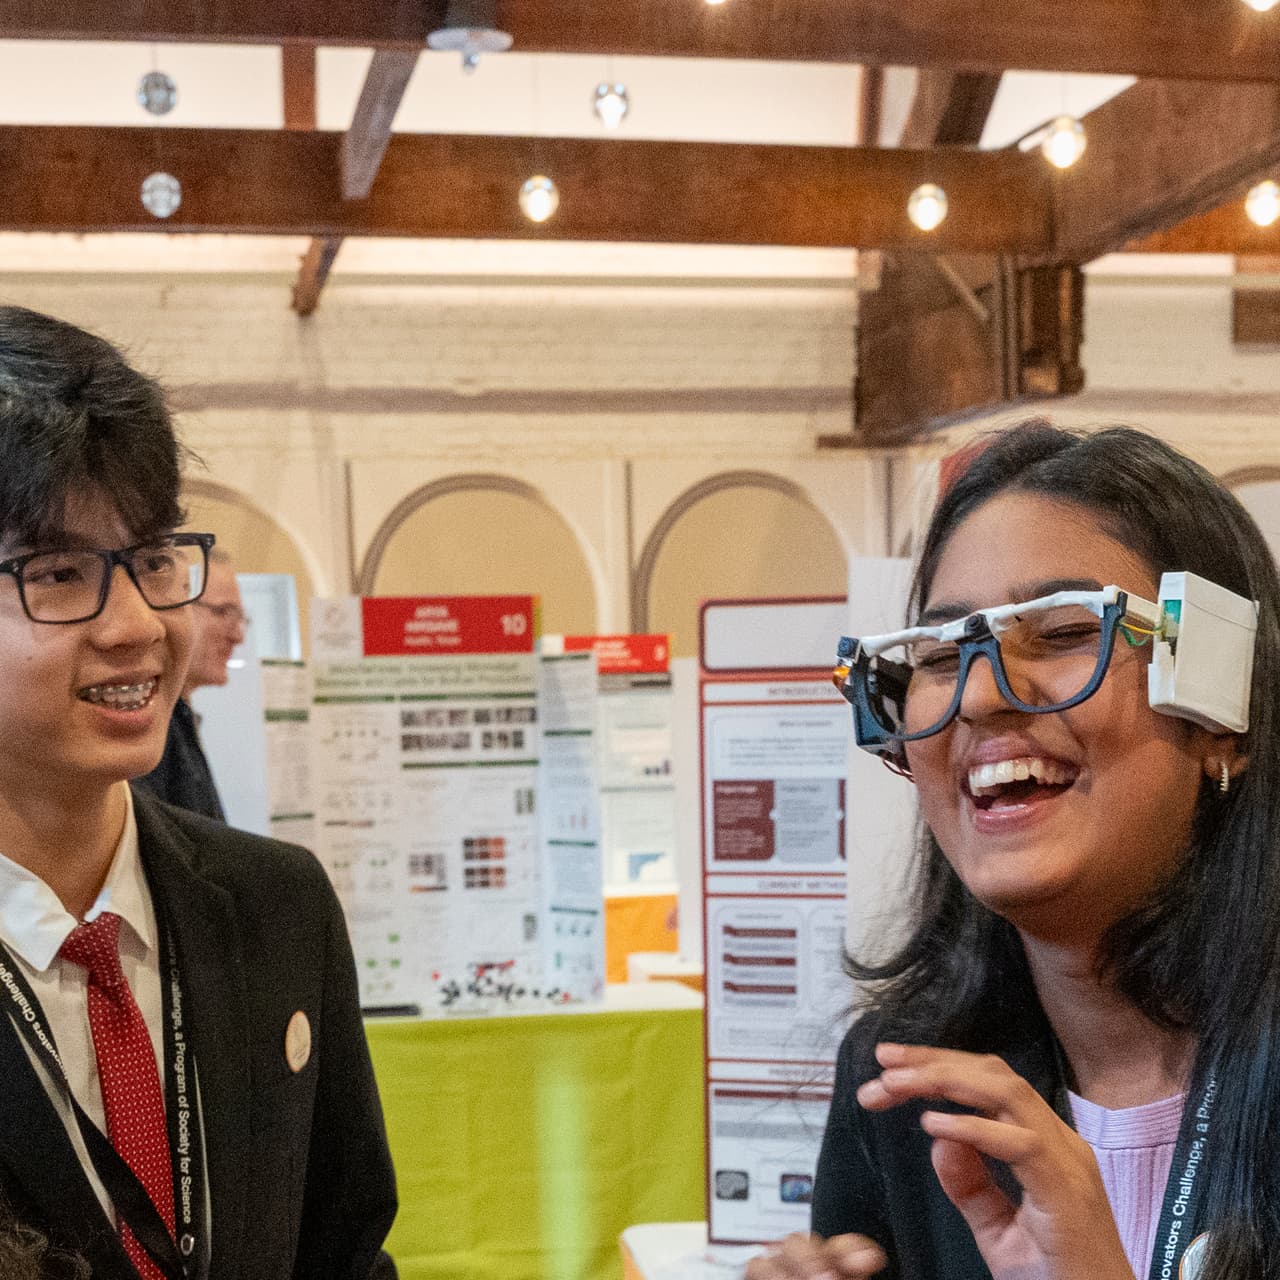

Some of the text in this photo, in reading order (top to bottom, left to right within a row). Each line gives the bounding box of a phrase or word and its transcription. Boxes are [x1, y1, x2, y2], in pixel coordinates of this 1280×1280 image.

[500, 612, 528, 637] 10
[174, 1042, 187, 1093] Program
[178, 1095, 189, 1108] of
[177, 1110, 191, 1155] Society
[180, 1156, 191, 1175] for
[1171, 1136, 1208, 1217] Challenge,
[1195, 1122, 1209, 1133] a
[181, 1176, 192, 1225] Science
